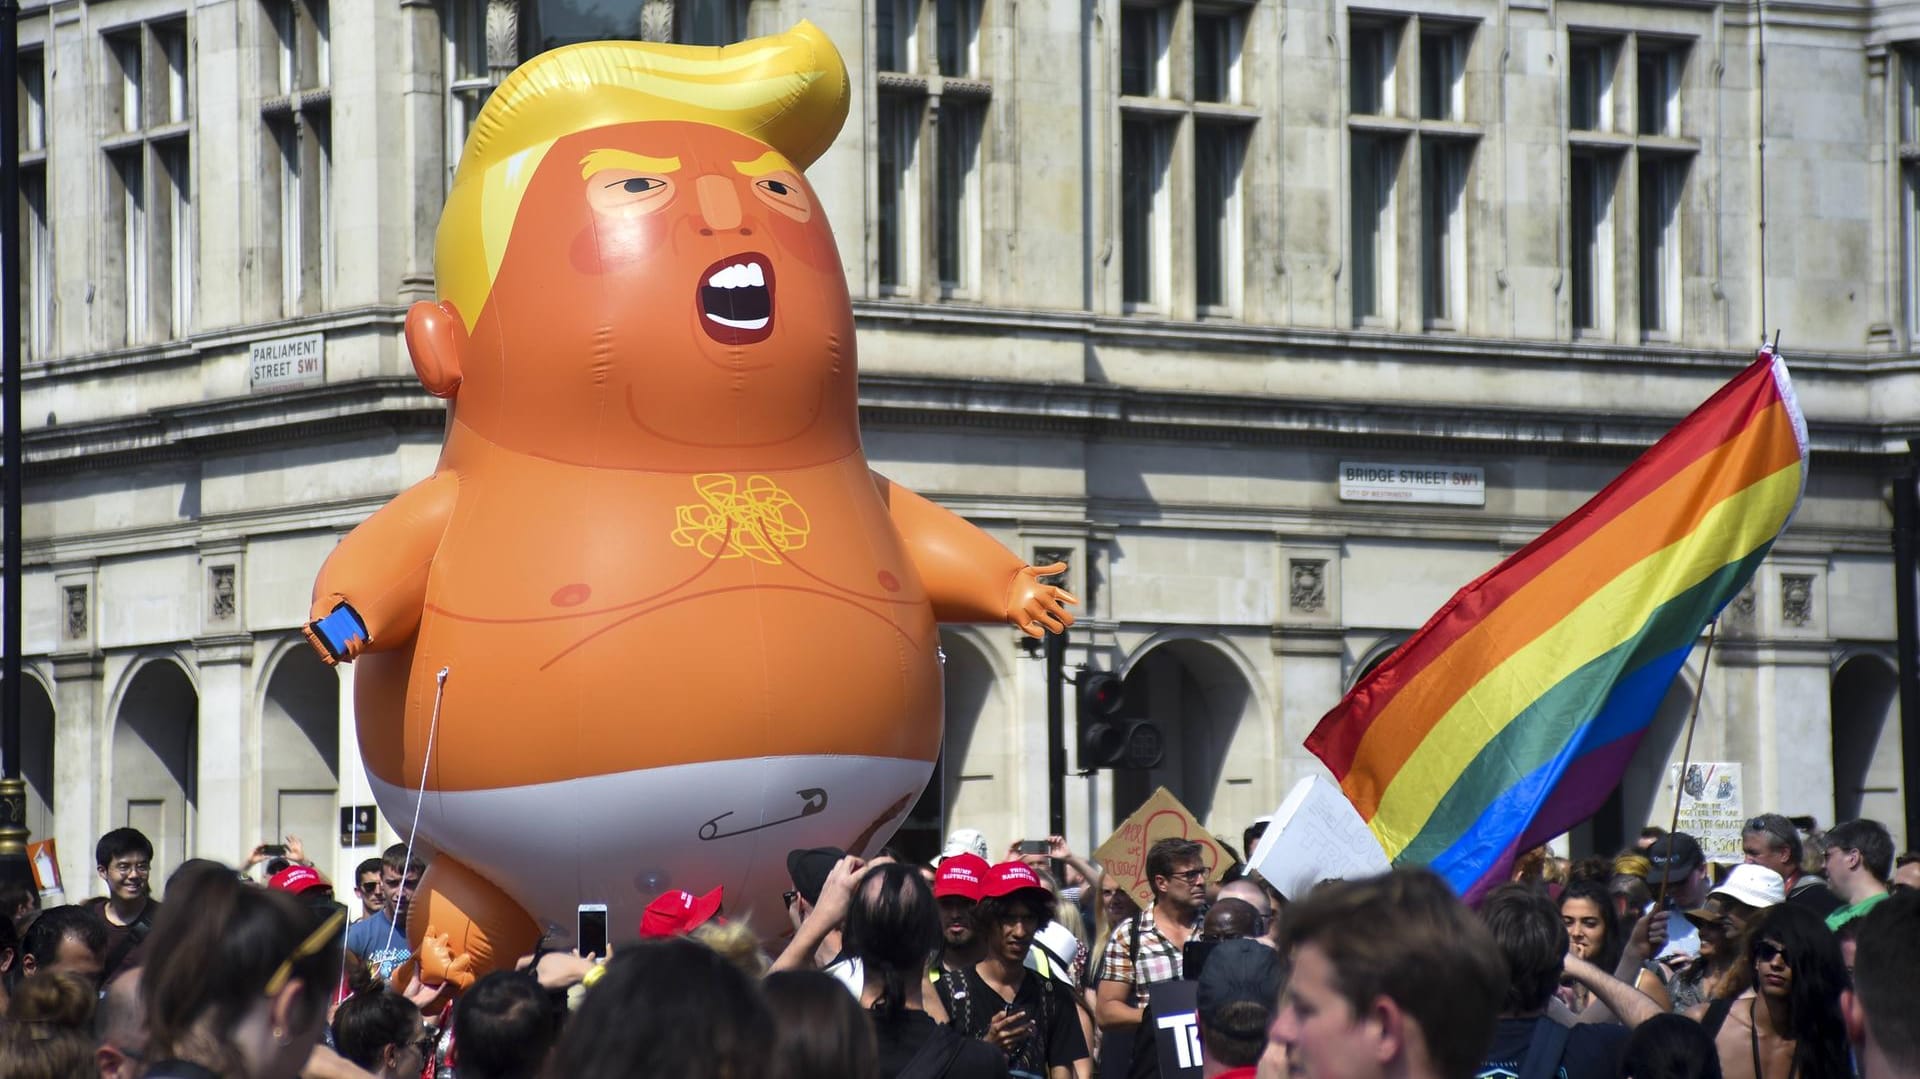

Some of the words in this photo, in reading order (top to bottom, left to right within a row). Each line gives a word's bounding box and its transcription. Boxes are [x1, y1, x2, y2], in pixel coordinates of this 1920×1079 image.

[254, 340, 317, 361] PARLIAMENT
[254, 361, 291, 380] STREET
[298, 357, 318, 374] SW1
[1346, 468, 1395, 483] BRIDGE
[1399, 470, 1448, 484] STREET
[1452, 472, 1478, 486] SW1
